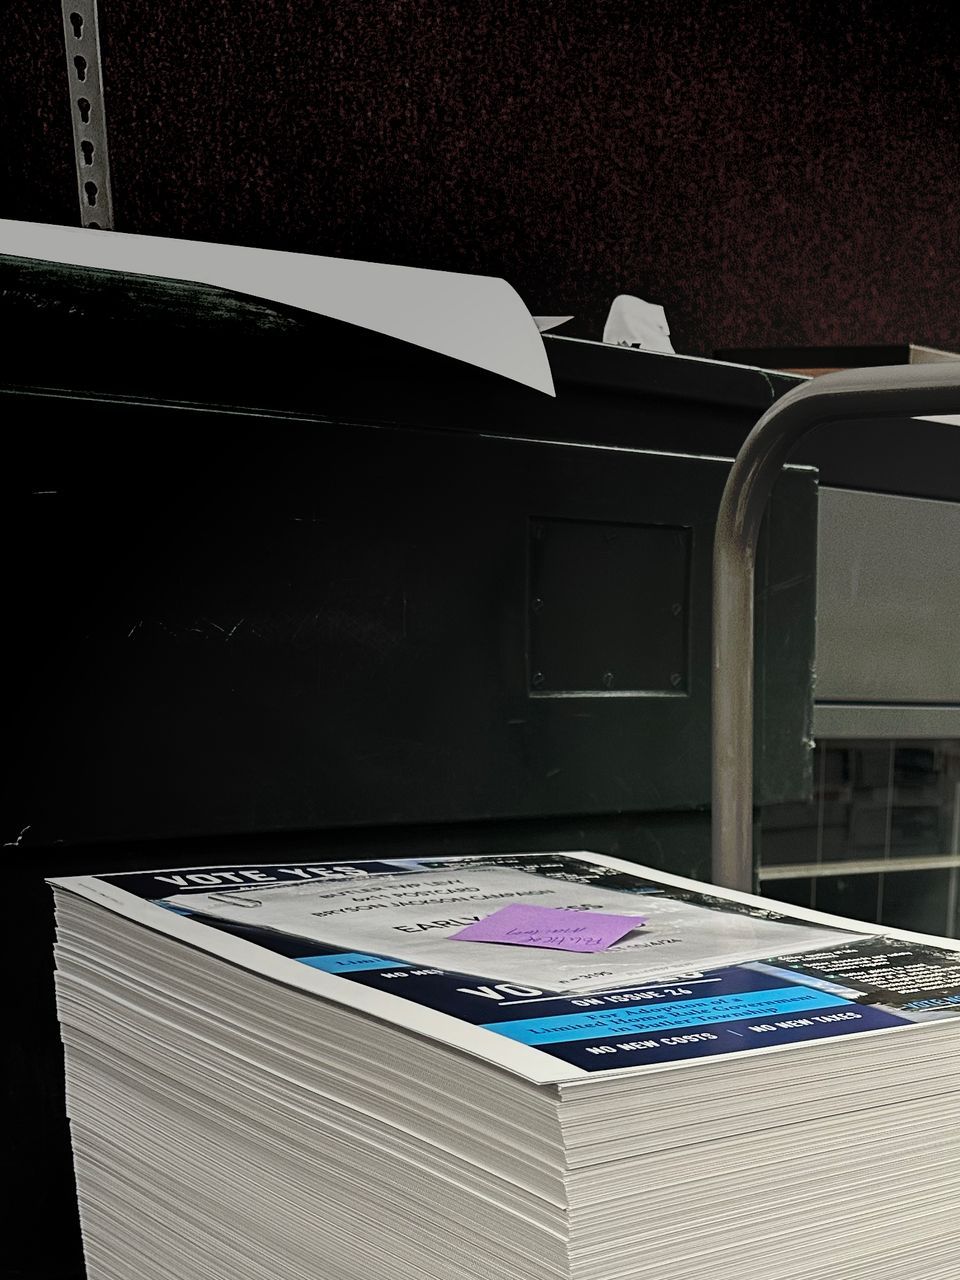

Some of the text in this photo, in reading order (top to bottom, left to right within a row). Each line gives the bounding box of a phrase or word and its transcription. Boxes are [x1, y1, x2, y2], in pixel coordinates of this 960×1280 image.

[154, 865, 370, 887] VOTE YES
[312, 889, 556, 917] BRYSON JACKSON CAMPAIGN
[392, 886, 480, 898] POSTCARD
[336, 957, 381, 966] Limi
[380, 971, 409, 979] NO
[456, 984, 543, 1000] VO
[570, 986, 693, 1007] ON ISSUE 26
[529, 995, 817, 1035] Limited Home Rule Government
[585, 1012, 617, 1021] For
[625, 1001, 716, 1017] Adoption
[716, 998, 730, 1007] of
[903, 998, 943, 1010] VOTE
[608, 1008, 779, 1033] in Butler Township
[747, 1012, 863, 1034] NO NEW TAXES
[585, 1032, 719, 1055] NO NEW COSTS
